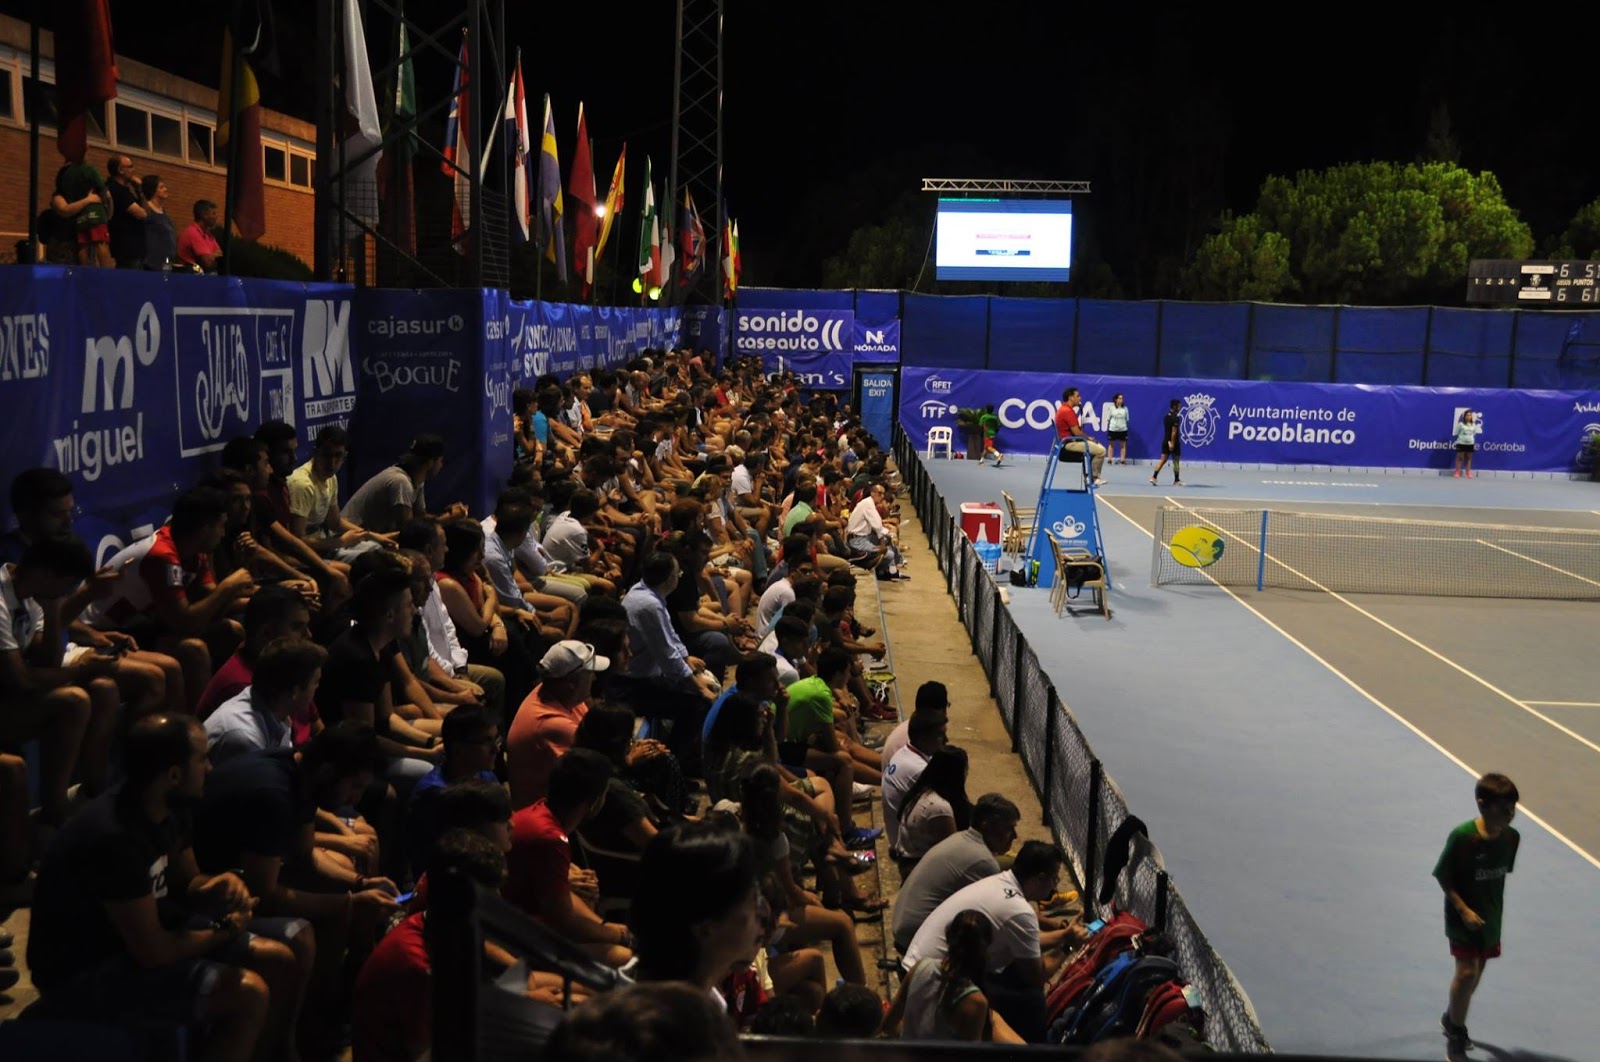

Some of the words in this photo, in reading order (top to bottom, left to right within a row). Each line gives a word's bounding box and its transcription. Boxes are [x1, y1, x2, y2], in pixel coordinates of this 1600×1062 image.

[1561, 264, 1569, 278] 6
[1573, 278, 1594, 286] PUNTOS
[1557, 288, 1566, 302] 6
[368, 315, 446, 338] cajasur
[738, 309, 819, 333] sonido
[737, 334, 819, 350] caseauto
[863, 379, 893, 388] SALIDA
[932, 381, 952, 389] RFET
[868, 389, 886, 397] EXIT
[922, 406, 946, 419] ITF
[1228, 404, 1332, 421] Ayuntamiento
[1337, 407, 1356, 422] de
[1228, 421, 1356, 445] Pozoblanco
[53, 411, 144, 482] miguel
[1483, 441, 1525, 452] Córdoba
